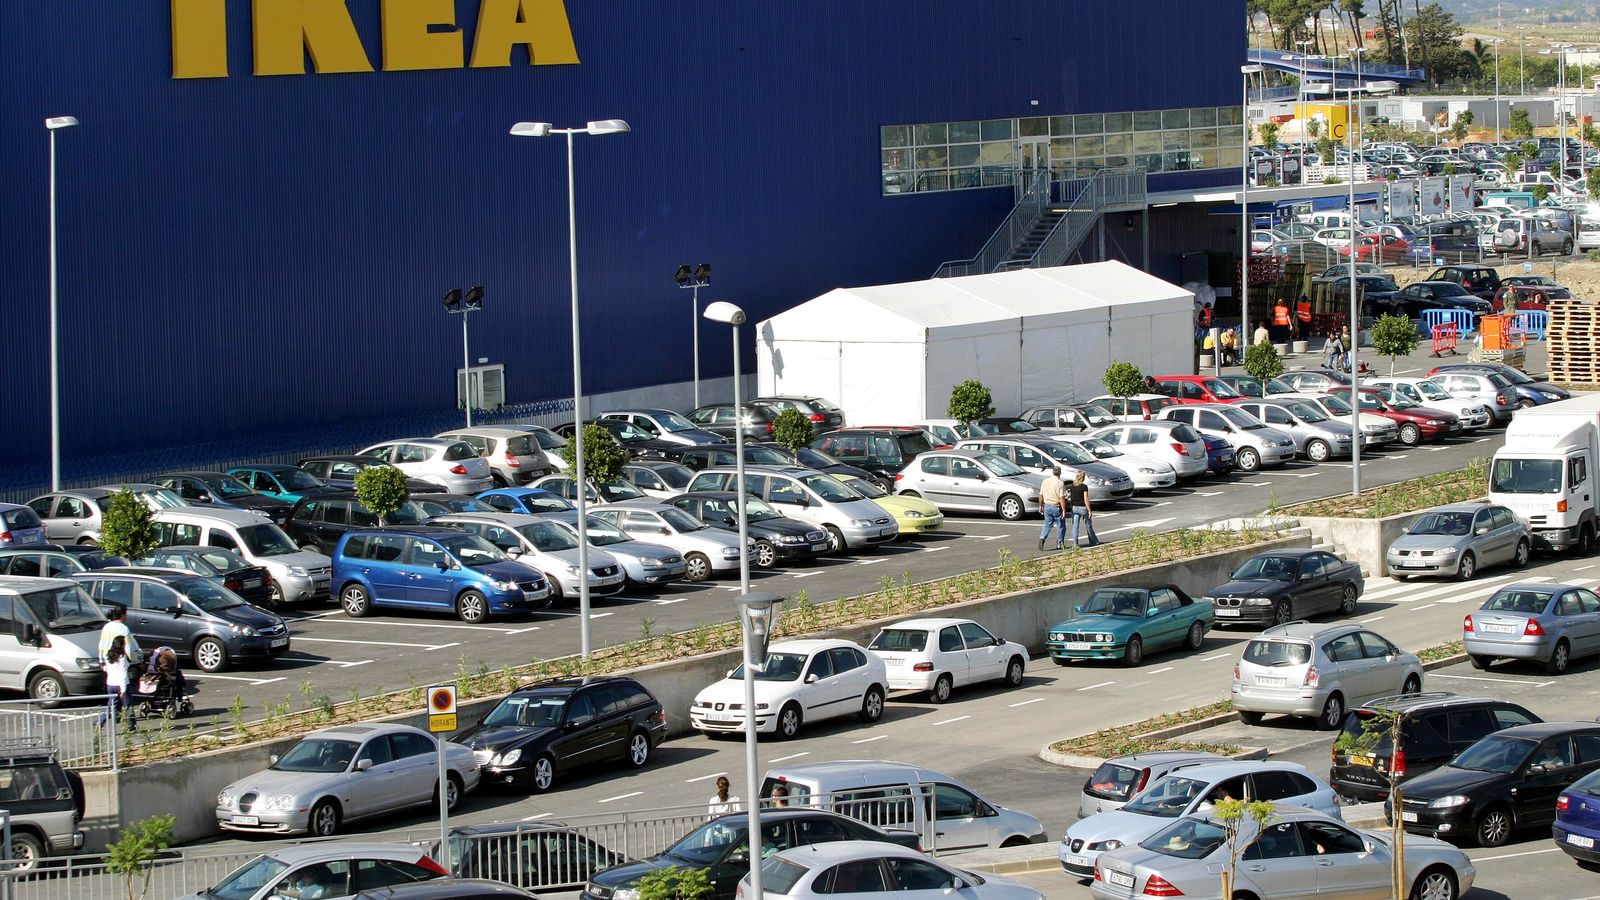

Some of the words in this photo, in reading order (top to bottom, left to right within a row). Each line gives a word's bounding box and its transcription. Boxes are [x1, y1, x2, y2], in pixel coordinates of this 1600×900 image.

[171, 0, 581, 79] IKEA
[1333, 124, 1344, 138] C
[431, 718, 456, 728] HIDRANTE
